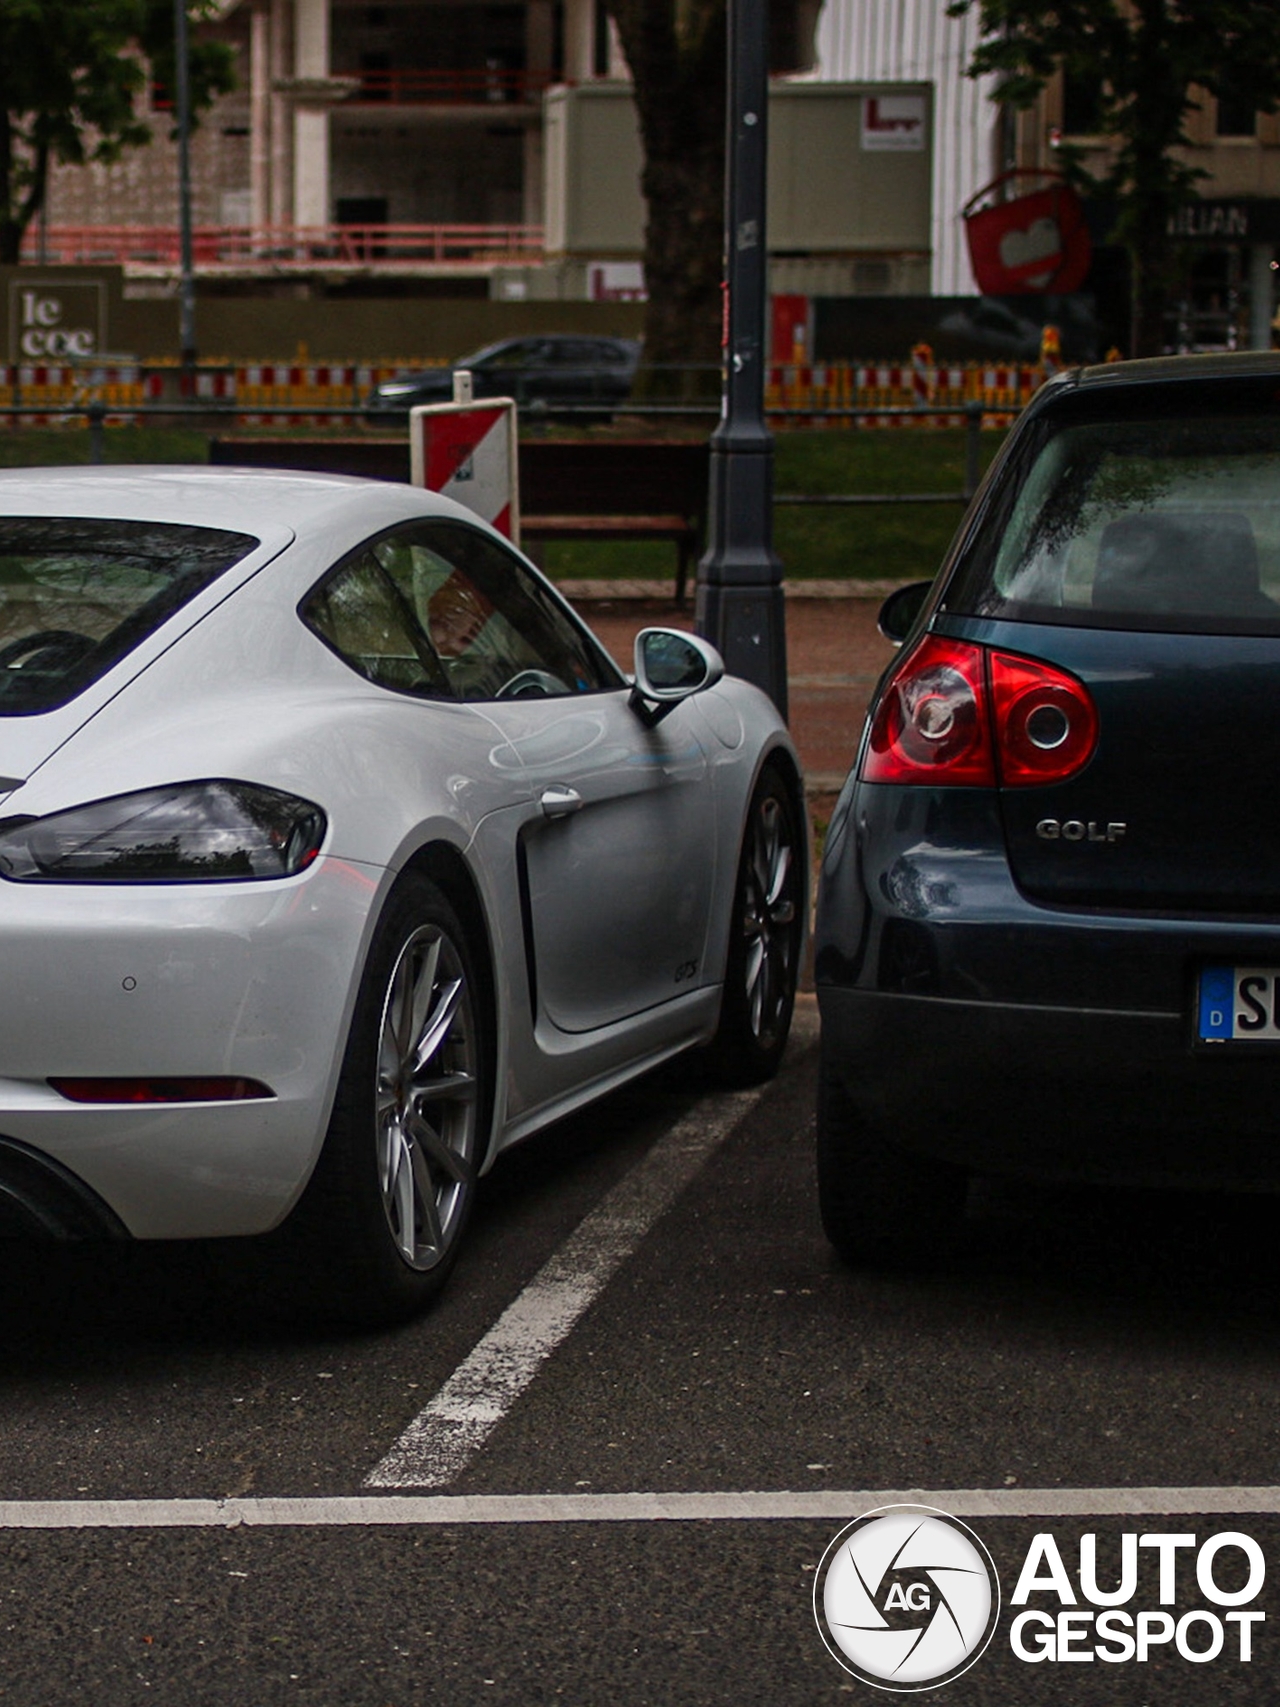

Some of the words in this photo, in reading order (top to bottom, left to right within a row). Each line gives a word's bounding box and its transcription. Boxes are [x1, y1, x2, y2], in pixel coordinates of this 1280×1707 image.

[22, 292, 63, 326] le
[1035, 818, 1127, 842] GOLF
[1209, 1010, 1223, 1026] D
[1236, 976, 1280, 1031] S
